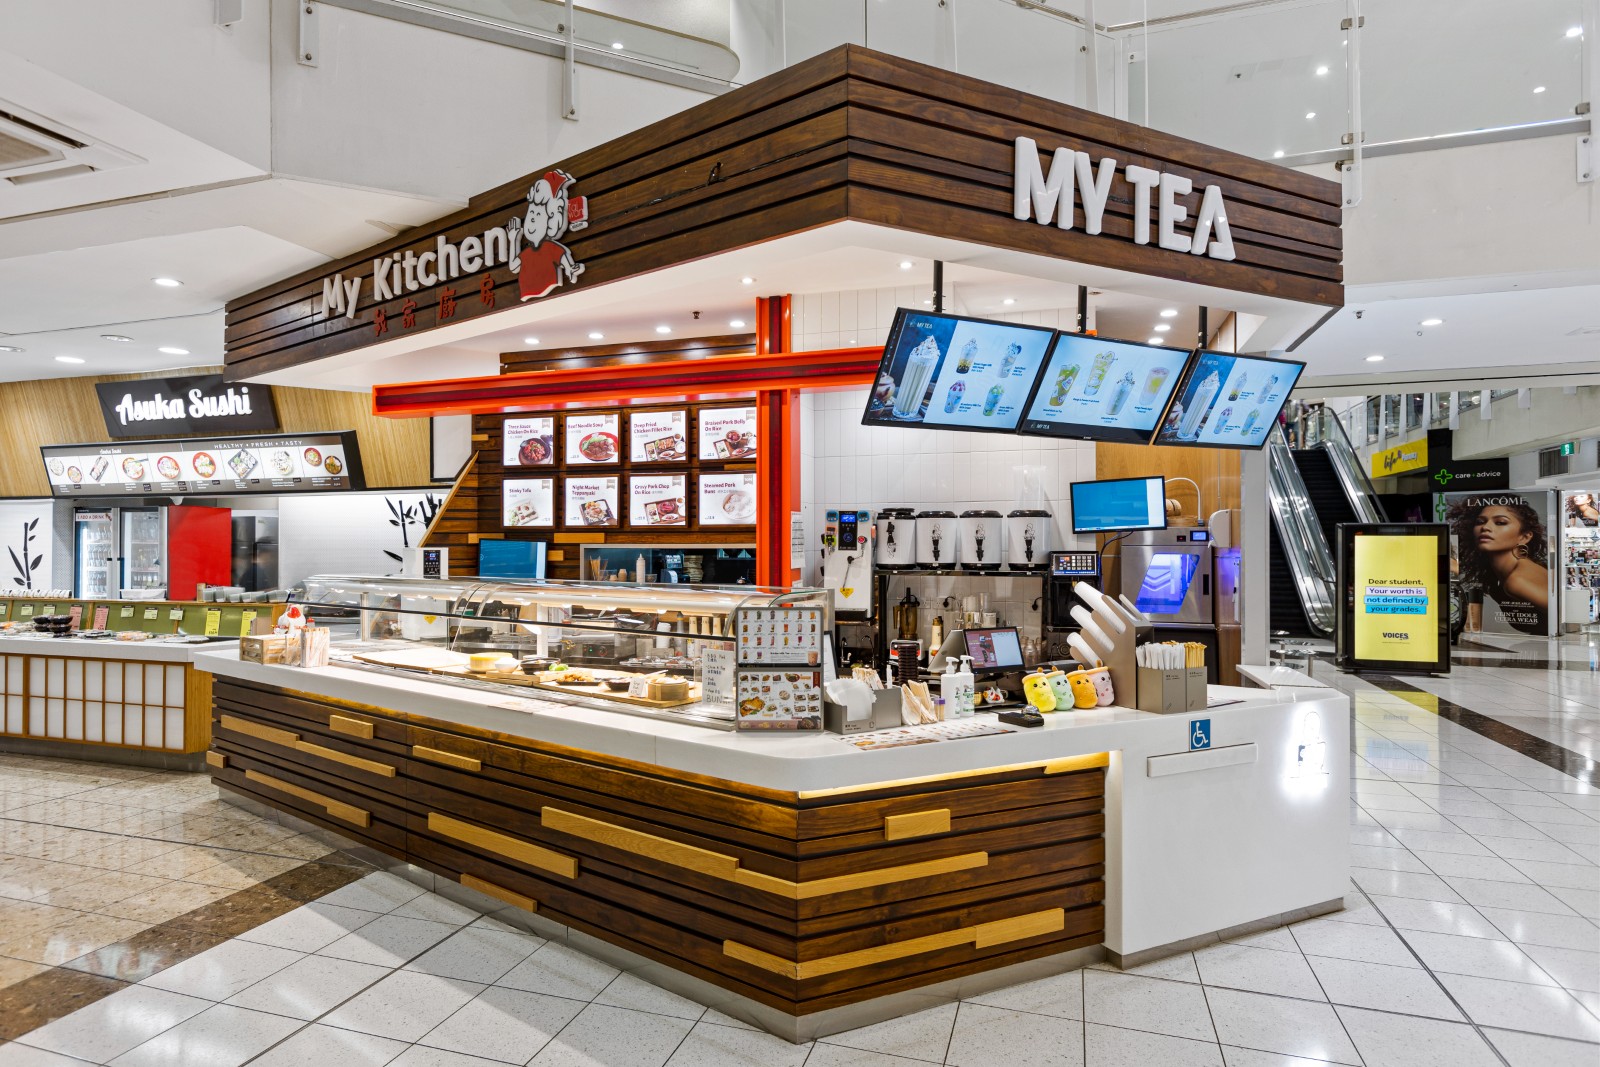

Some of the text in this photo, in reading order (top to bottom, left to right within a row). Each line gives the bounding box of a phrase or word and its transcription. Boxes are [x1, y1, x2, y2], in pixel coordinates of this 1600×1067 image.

[1014, 136, 1236, 261] MY TEA
[321, 226, 508, 319] My Kitchen
[373, 273, 496, 336] 我家廚房
[115, 386, 252, 425] Asuka Sushi
[1467, 496, 1527, 507] LANCÔME
